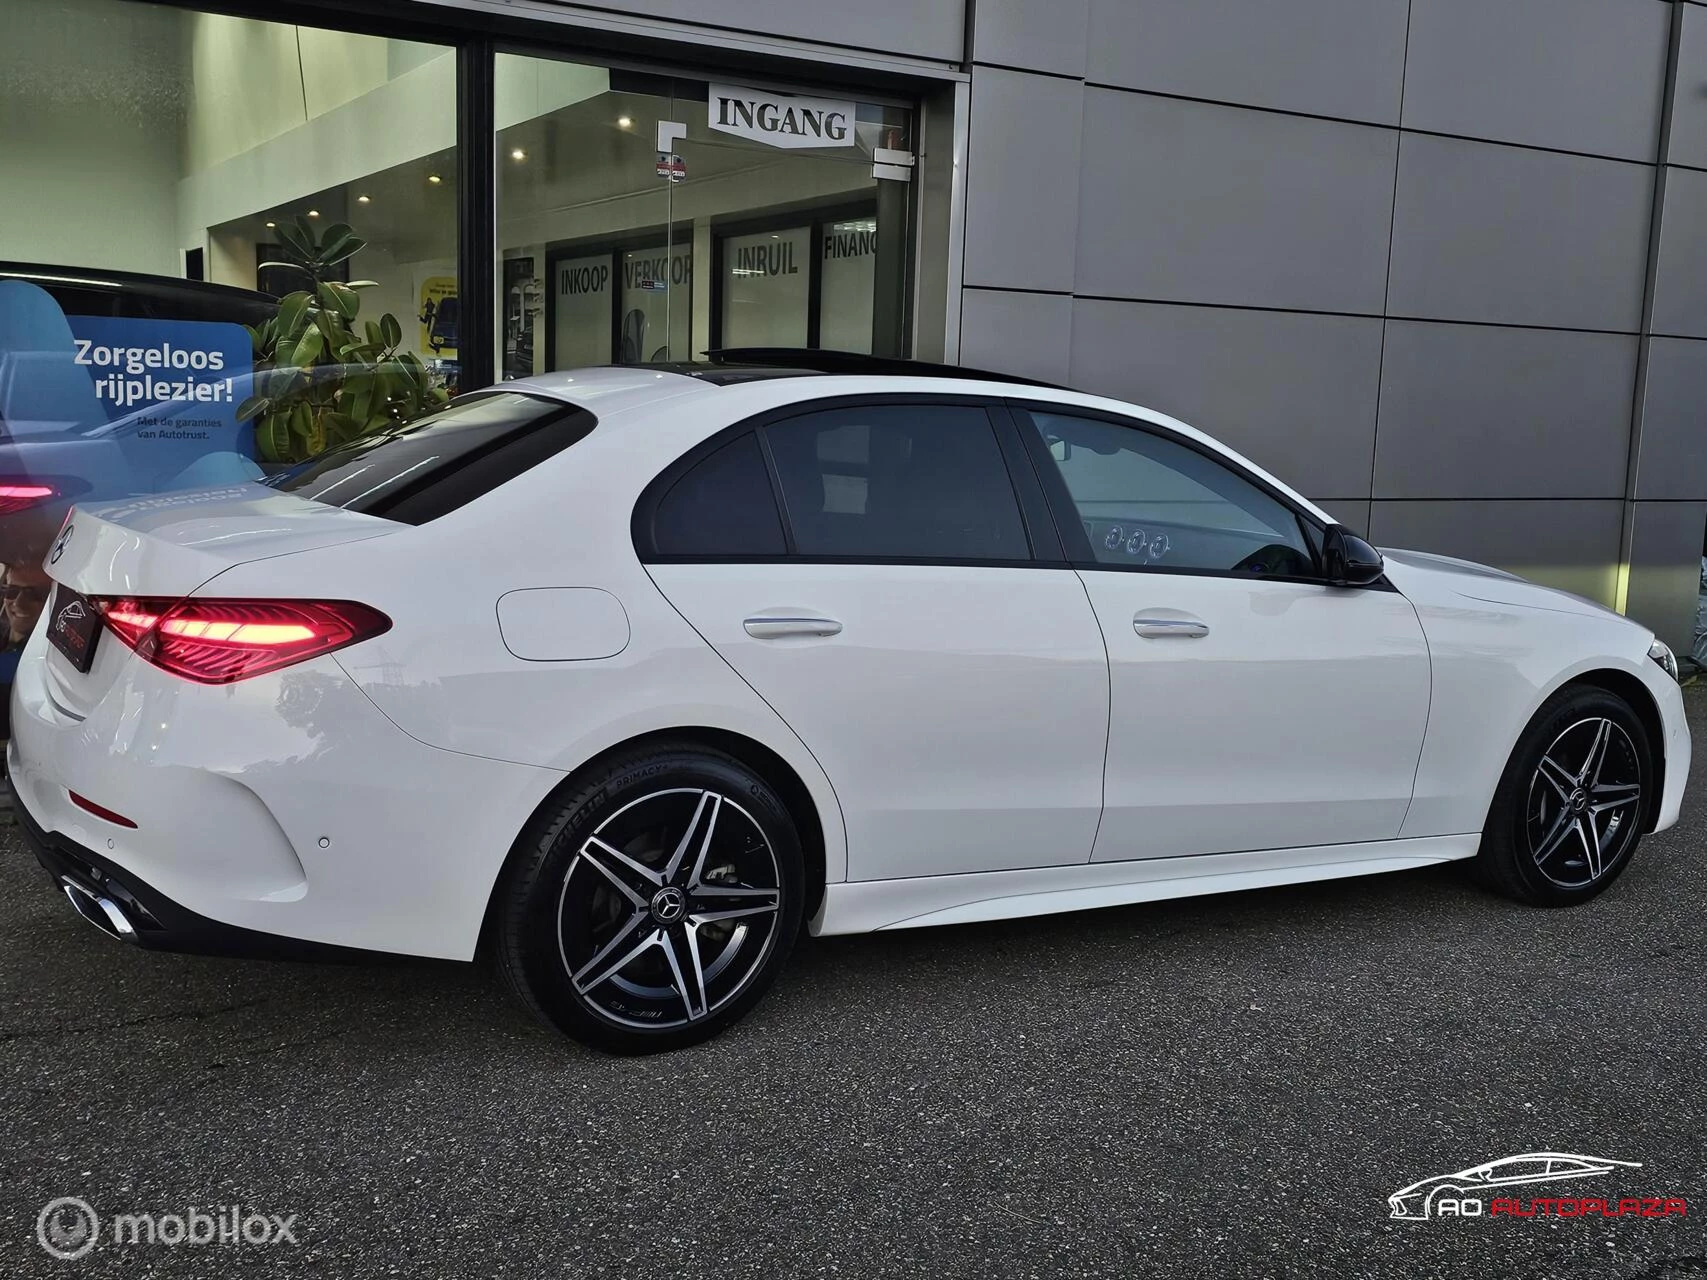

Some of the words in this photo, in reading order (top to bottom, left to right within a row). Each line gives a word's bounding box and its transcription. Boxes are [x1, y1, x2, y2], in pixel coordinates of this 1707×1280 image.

[717, 97, 847, 141] INGANG
[737, 242, 798, 279] INRUIL
[561, 264, 609, 295] INKOOP
[73, 339, 224, 375] Zorgeloos
[95, 373, 233, 406] rijplezier!
[137, 417, 158, 426] Met
[160, 417, 173, 427] de
[175, 418, 222, 429] garanties
[137, 430, 156, 439] van
[159, 429, 210, 440] Autotrust.
